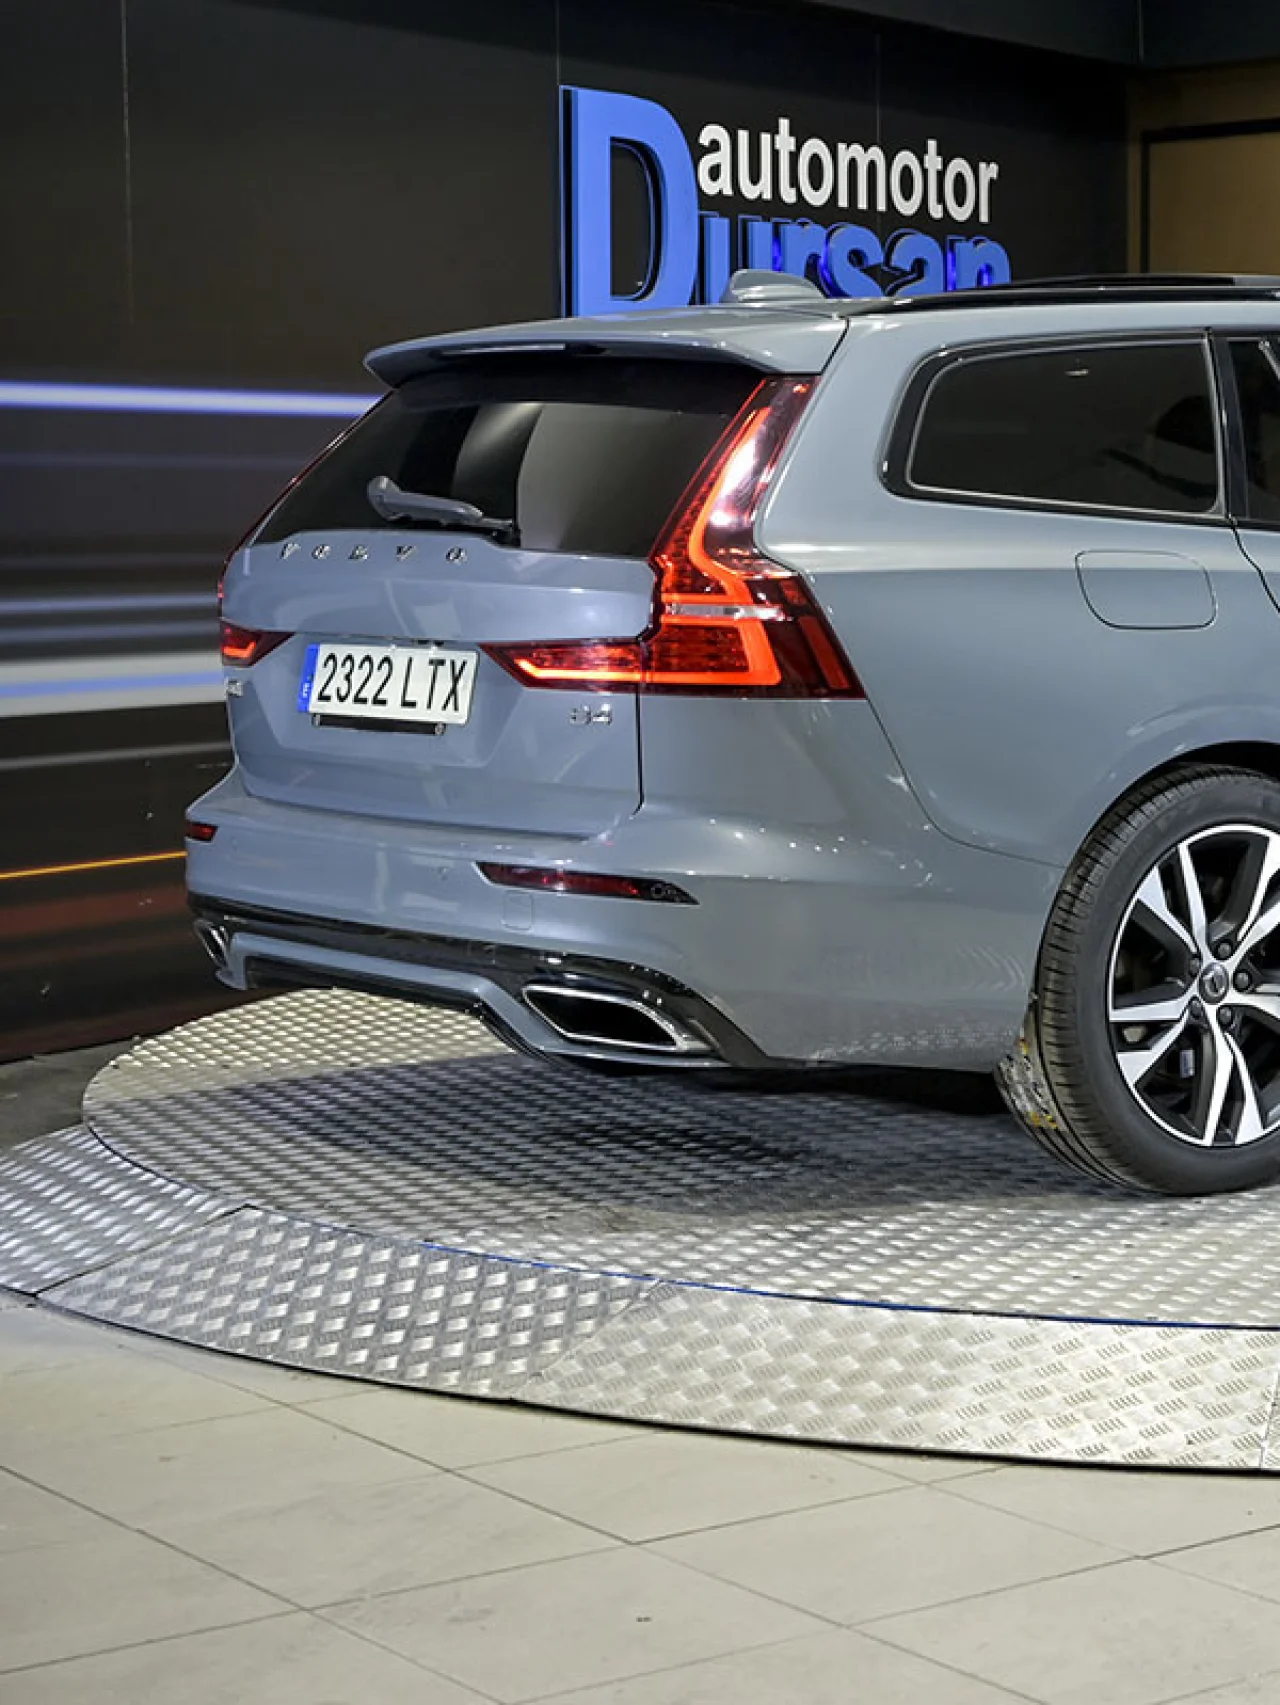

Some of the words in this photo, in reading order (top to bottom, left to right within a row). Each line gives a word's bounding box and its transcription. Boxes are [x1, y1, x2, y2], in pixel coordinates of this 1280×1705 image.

[560, 85, 1011, 318] Dursan
[699, 117, 999, 223] automotor
[280, 542, 468, 565] VOLVO
[317, 653, 394, 707] 2322
[401, 657, 468, 712] LTX
